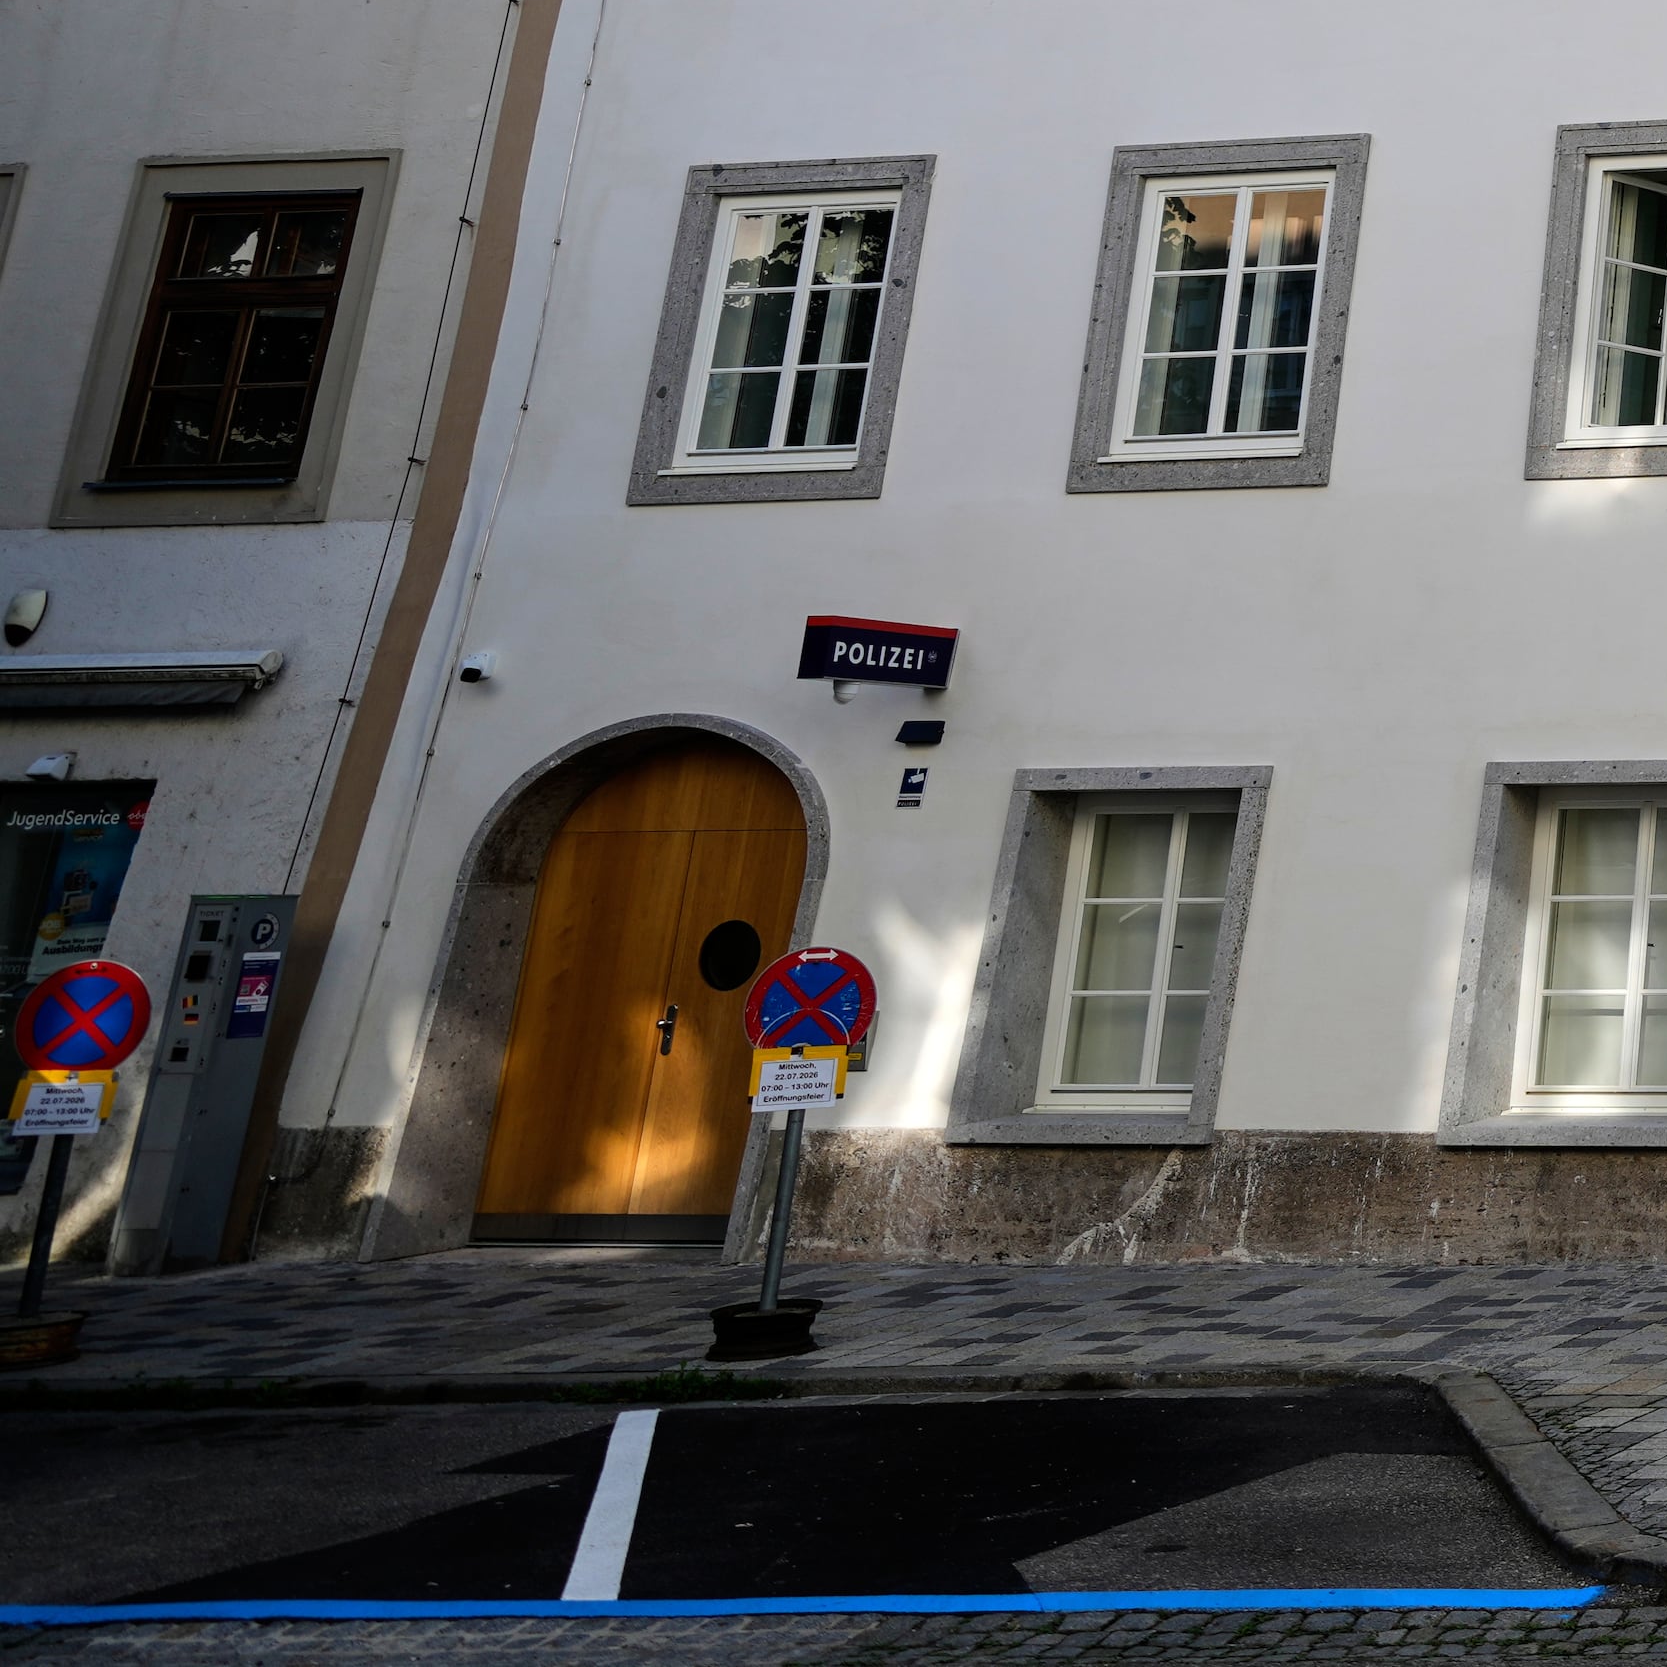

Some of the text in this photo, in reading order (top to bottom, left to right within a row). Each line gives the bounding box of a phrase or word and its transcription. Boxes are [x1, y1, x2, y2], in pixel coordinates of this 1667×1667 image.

[833, 641, 925, 670] POLIZEI
[6, 808, 120, 830] JugendService
[775, 1072, 819, 1081] 22.07.2026
[761, 1084, 784, 1092] 07:00
[792, 1082, 813, 1090] 13:00
[815, 1081, 830, 1089] Uhr
[40, 1097, 85, 1105] 22.07.2026
[763, 1093, 825, 1103] Eröffnungsfeier
[24, 1108, 48, 1116] 07:00
[25, 1118, 89, 1127] Eröffnungsfeier
